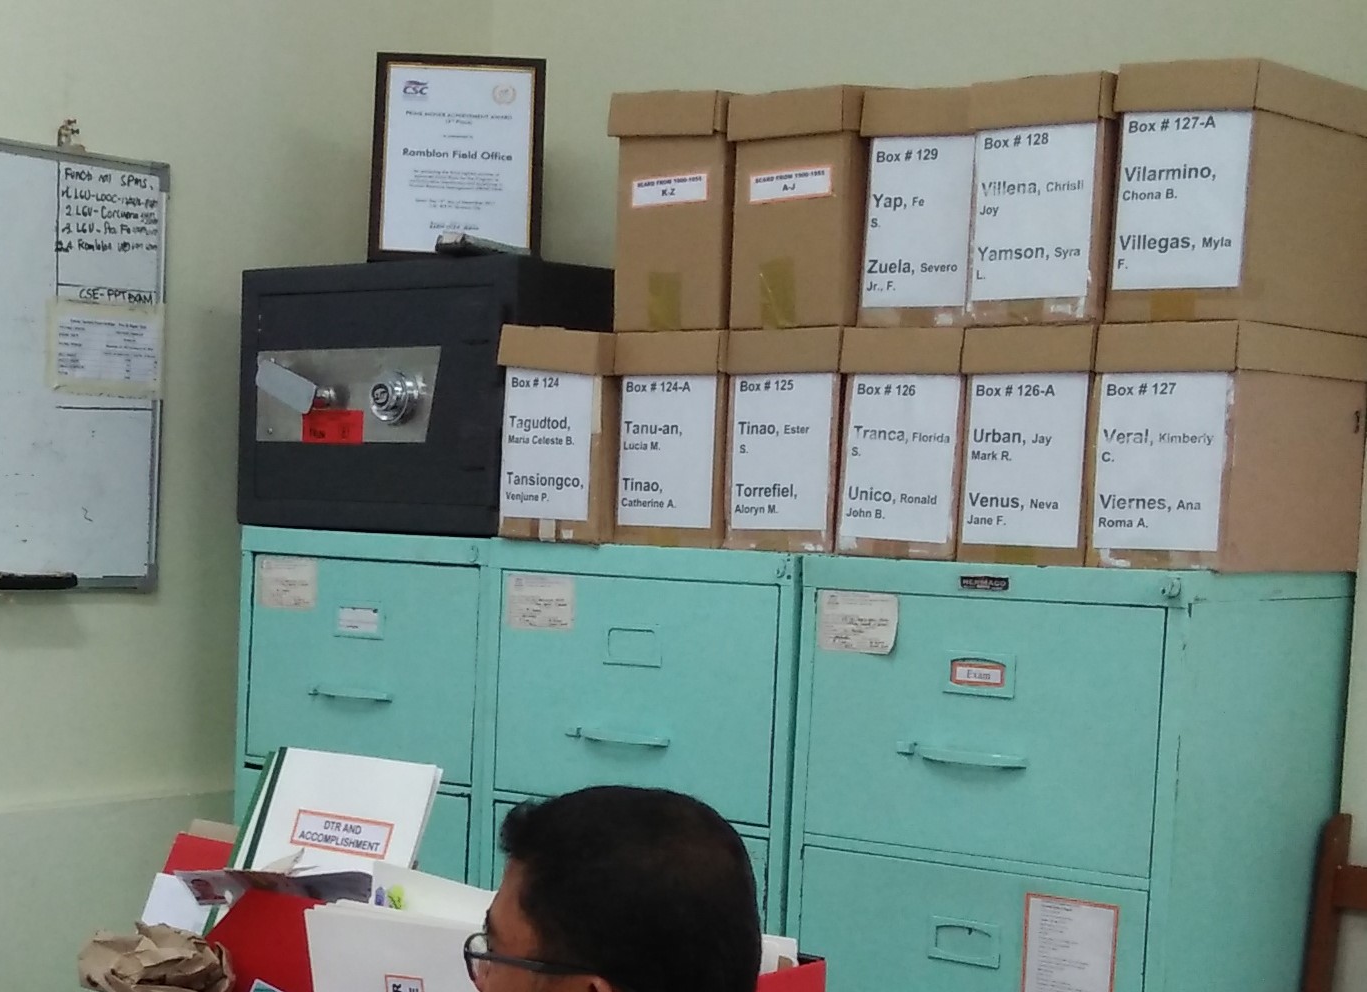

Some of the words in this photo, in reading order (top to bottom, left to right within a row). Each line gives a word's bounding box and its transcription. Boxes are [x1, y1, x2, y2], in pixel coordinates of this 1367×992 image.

[403, 86, 428, 96] CSC
[1128, 120, 1155, 134] Box
[1160, 119, 1169, 131] #
[1174, 116, 1216, 131] 127-A
[984, 137, 1009, 150] Box
[1013, 136, 1021, 147] #
[1027, 133, 1049, 146] 128
[402, 148, 449, 160] Romblon
[452, 150, 477, 161] Field
[481, 151, 513, 162] Office
[877, 150, 899, 163] Box
[904, 150, 913, 162] #
[917, 148, 938, 161] 129
[1124, 164, 1216, 183] Vilarmino,
[981, 180, 1041, 197] Villena,
[1122, 189, 1161, 202] Chona
[1165, 188, 1178, 200] B.
[873, 194, 907, 210] Yap,
[913, 196, 925, 207] Fe
[980, 205, 999, 217] Joy
[871, 218, 881, 229] S.
[1119, 235, 1196, 254] Villegas,
[1202, 236, 1232, 249] Myla
[978, 245, 1050, 261] Yamson,
[1054, 247, 1081, 261] Syra
[867, 259, 915, 275] Zuela,
[920, 262, 958, 274] Severo
[1117, 258, 1128, 270] F.
[976, 270, 985, 280] L.
[886, 281, 896, 291] F.
[511, 376, 531, 388] Box
[533, 376, 540, 388] #
[543, 376, 560, 388] 124
[626, 381, 647, 393] Box
[650, 381, 657, 392] #
[660, 381, 691, 393] 124-A
[740, 380, 761, 392] Box
[764, 380, 772, 391] #
[774, 379, 794, 391] 125
[1106, 382, 1134, 396] Box
[1137, 382, 1147, 395] #
[1152, 382, 1177, 395] 127
[856, 383, 882, 396] Box
[884, 384, 892, 395] #
[897, 383, 916, 396] 126
[976, 384, 1001, 397] Box
[1005, 384, 1013, 397] #
[1018, 383, 1056, 397] 126-A
[509, 415, 571, 432] Tagudtod,
[625, 421, 682, 437] Tanu-an,
[738, 422, 780, 437] Tinao,
[784, 424, 810, 435] Ester
[508, 435, 530, 446] Maria
[532, 435, 563, 446] Celeste
[565, 436, 575, 446] B.
[854, 426, 909, 444] Tranca,
[912, 431, 951, 444] Florida
[973, 428, 1027, 446] Urban,
[1031, 434, 1052, 446] Jay
[1103, 428, 1154, 446] Veral,
[1158, 432, 1215, 447] Kimberly
[623, 440, 648, 451] Lucia
[649, 441, 661, 451] M.
[739, 444, 749, 454] S.
[851, 447, 861, 457] S.
[971, 449, 998, 461] Mark
[1000, 449, 1013, 461] R.
[1101, 452, 1115, 463] C.
[506, 472, 584, 491] Tansiongco,
[622, 478, 663, 494] Tinao,
[506, 492, 540, 503] Venjune
[541, 492, 550, 502] P.
[736, 483, 798, 500] Torrefiel,
[848, 485, 896, 504] Unico,
[899, 492, 938, 505] Ronald
[621, 498, 665, 509] Catherine
[667, 499, 677, 508] A.
[969, 493, 1025, 511] Venus,
[1030, 498, 1060, 510] Neva
[1099, 494, 1173, 512] Viernes,
[1176, 499, 1202, 511] Ana
[734, 504, 765, 516] Aloryn
[767, 504, 779, 514] M.
[846, 507, 872, 519] John
[874, 508, 886, 519] B.
[967, 514, 993, 526] Jane
[995, 515, 1007, 526] F.
[1098, 516, 1133, 528] Roma
[1137, 516, 1149, 528] A.
[967, 669, 991, 680] Exam
[323, 820, 341, 833] DTR
[342, 823, 362, 835] AND
[298, 830, 380, 852] ACCOMPLISHMENT
